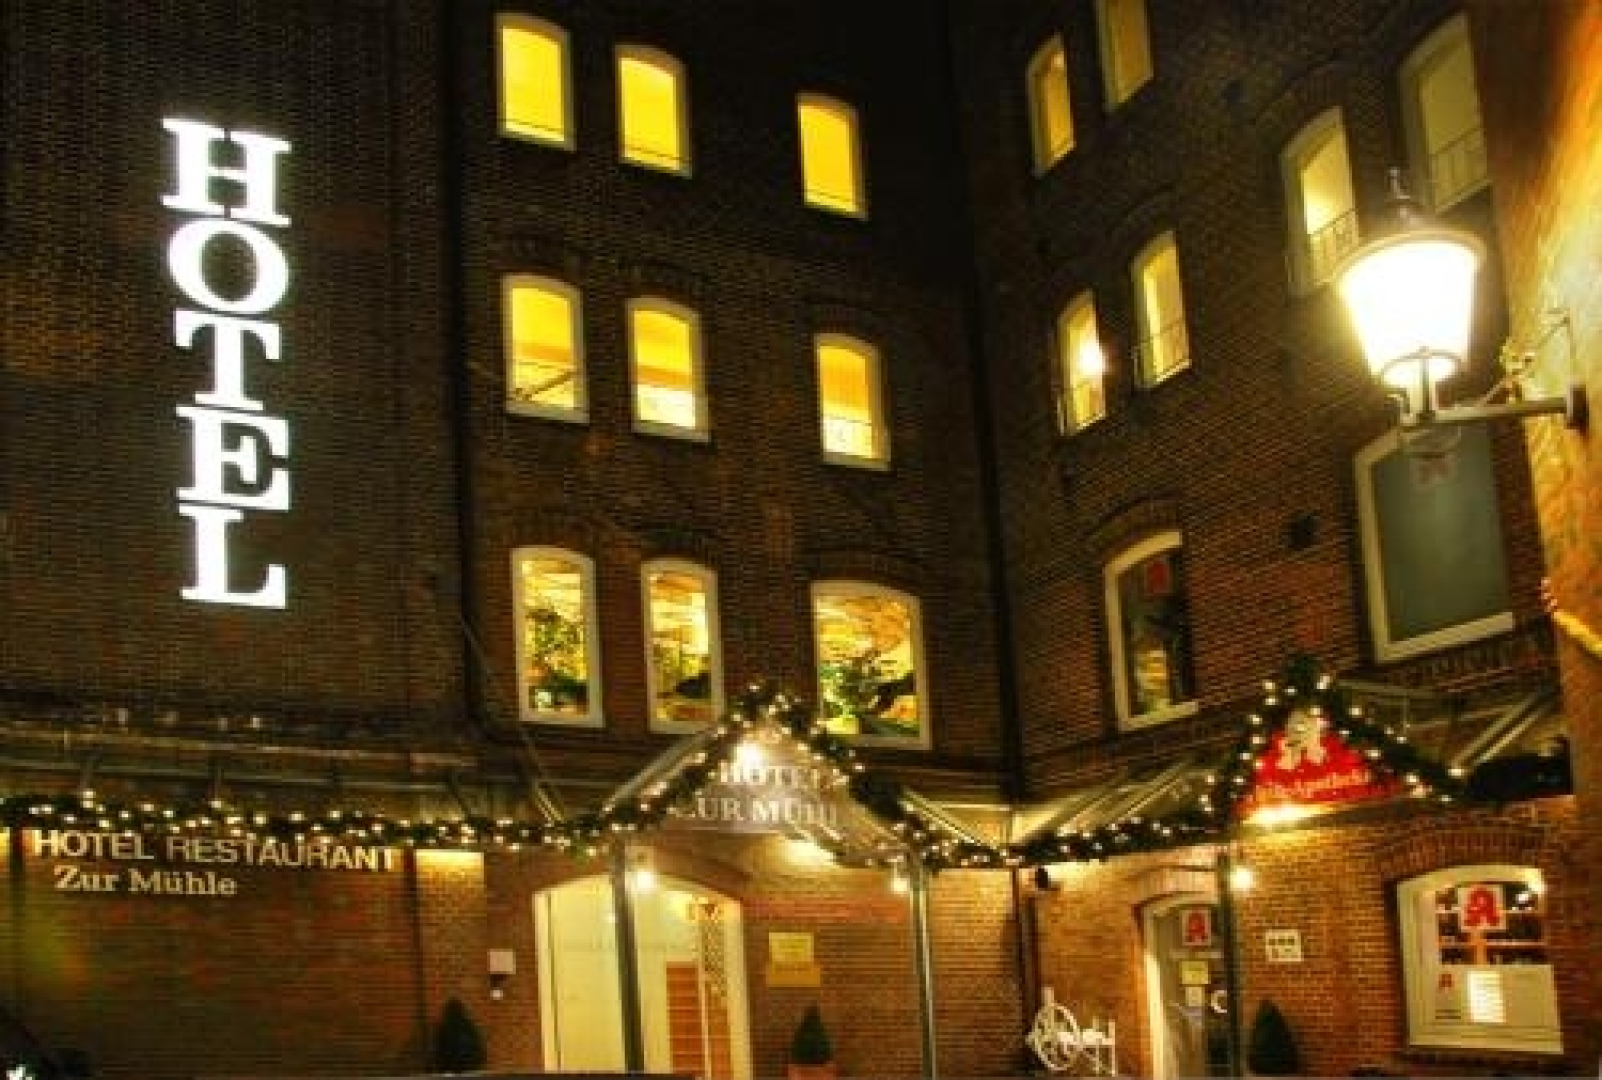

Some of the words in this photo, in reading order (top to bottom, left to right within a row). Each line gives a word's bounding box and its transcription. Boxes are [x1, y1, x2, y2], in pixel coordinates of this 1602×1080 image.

[161, 117, 292, 609] HOTEL
[34, 829, 155, 861] HOTEL
[166, 835, 395, 871] RESTAURANT
[53, 864, 120, 892] Zur
[128, 868, 238, 896] Mühle
